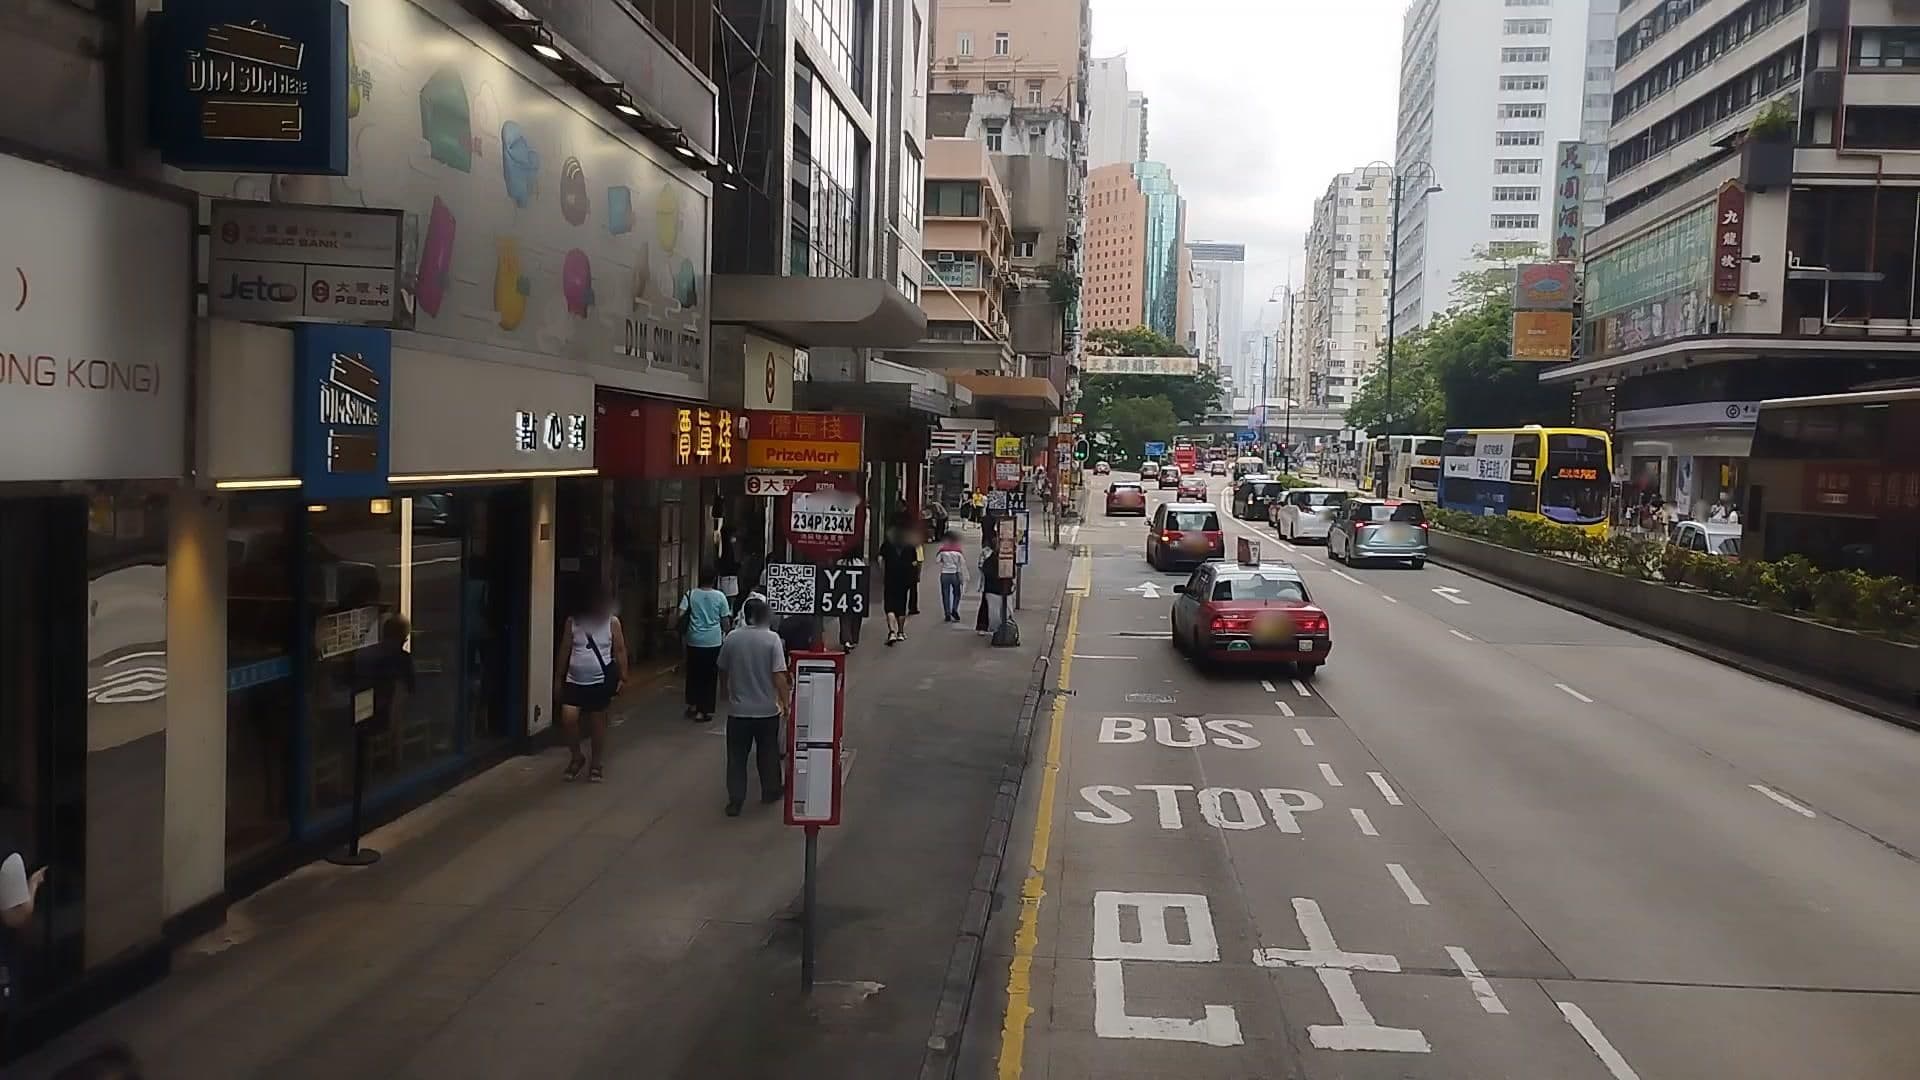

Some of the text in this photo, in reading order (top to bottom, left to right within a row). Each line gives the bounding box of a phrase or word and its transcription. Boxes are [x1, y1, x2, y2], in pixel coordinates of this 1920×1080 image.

[297, 238, 339, 249] BANK
[66, 356, 161, 398] KONG)
[766, 447, 840, 463] PrizeMart
[793, 514, 854, 532] 234P 234X
[824, 569, 862, 590] YT
[821, 592, 863, 613] 543
[1098, 716, 1262, 749] BUS
[1073, 784, 1325, 834] STOP
[1092, 890, 1432, 1053] 巴士
